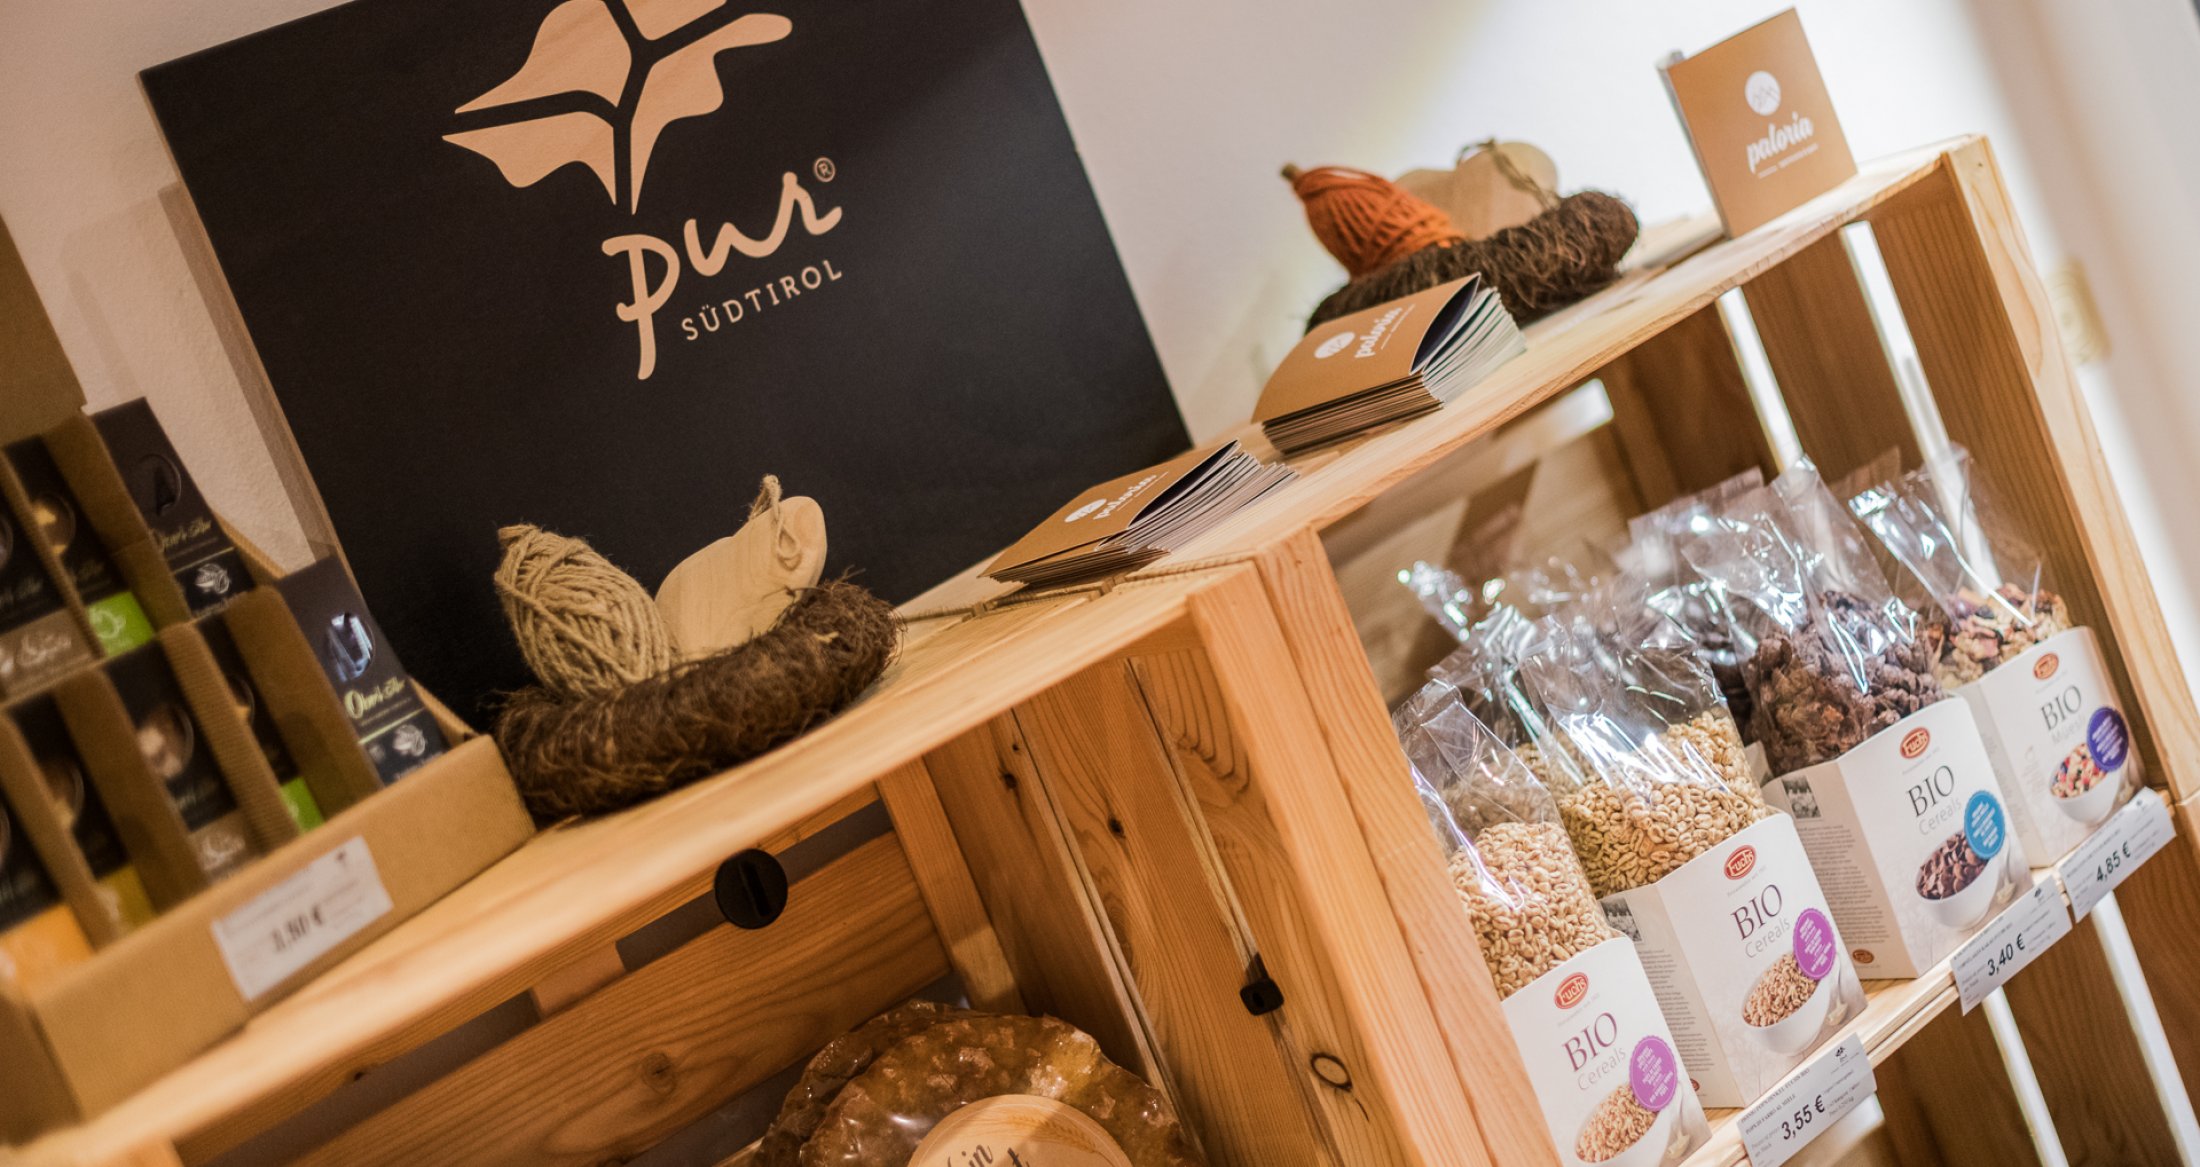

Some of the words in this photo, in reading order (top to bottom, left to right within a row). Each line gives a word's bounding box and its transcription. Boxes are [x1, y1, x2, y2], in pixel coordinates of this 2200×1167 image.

[1746, 111, 1814, 174] paloria
[681, 259, 842, 341] SÜDTIROL
[2041, 684, 2082, 731] BIO
[1906, 765, 1954, 818] BIO
[1919, 797, 1962, 836] Cereals
[1727, 849, 1755, 877] Fuchs
[2096, 850, 2121, 882] 4,85
[2122, 840, 2131, 858] €
[1730, 884, 1782, 941] BIO
[1745, 917, 1791, 959] Cereals
[1987, 943, 2014, 977] 3,40
[2016, 933, 2026, 950] €
[1558, 976, 1588, 1005] Fuchs
[1562, 1012, 1617, 1072] BIO
[1577, 1047, 1627, 1091] Cereals
[1781, 1104, 1813, 1140] 3,55
[1814, 1095, 1826, 1114] €
